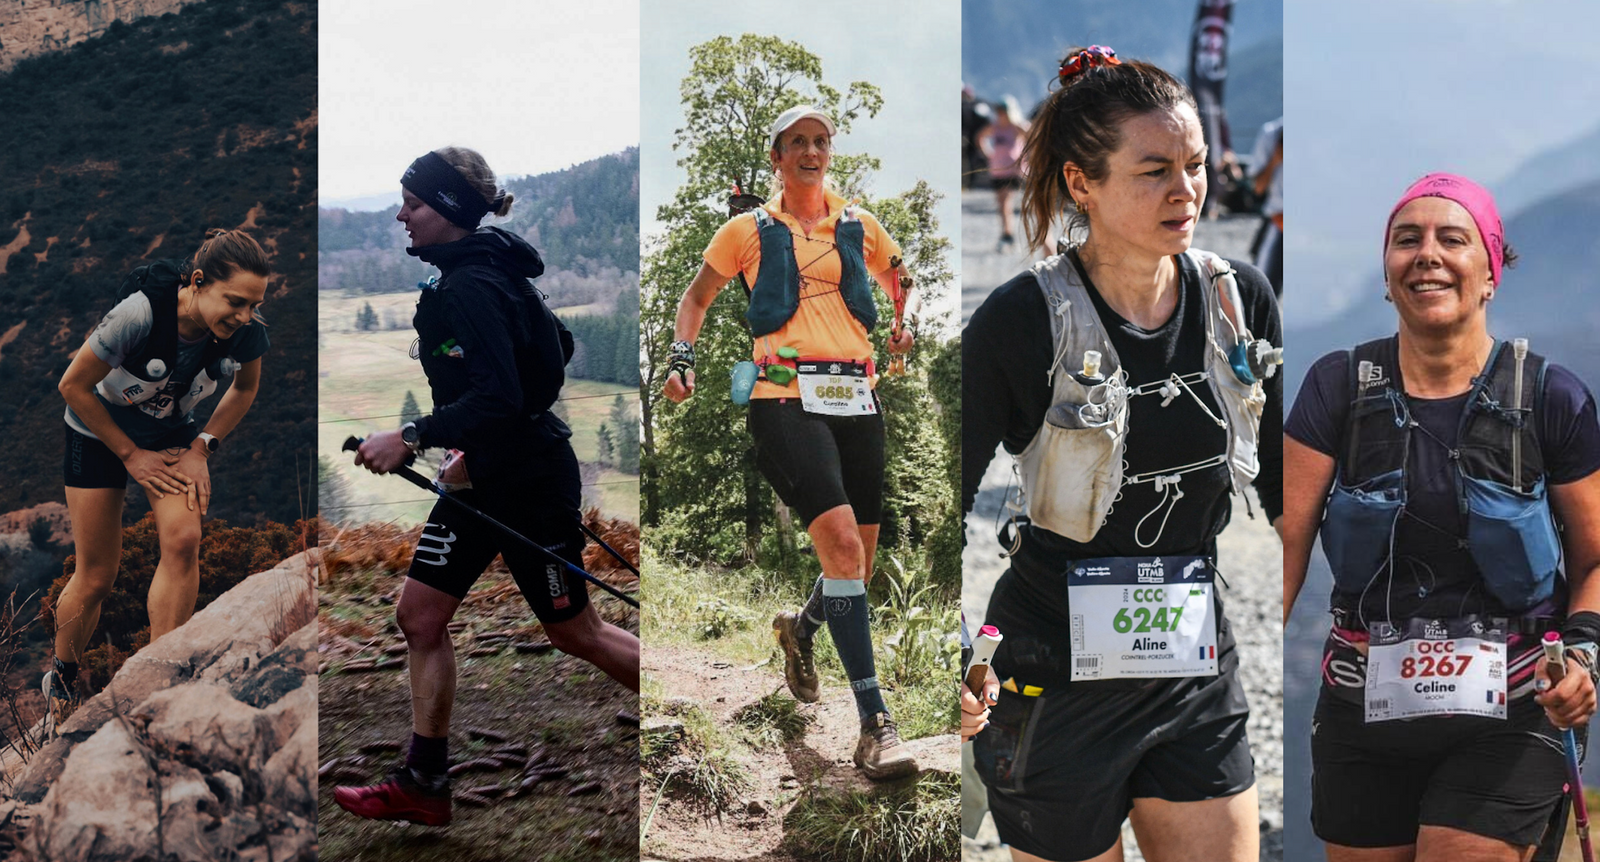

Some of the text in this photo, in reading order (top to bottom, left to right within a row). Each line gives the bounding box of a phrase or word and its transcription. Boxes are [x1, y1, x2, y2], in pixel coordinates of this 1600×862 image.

[815, 385, 854, 400] 6685
[1137, 568, 1164, 577] UTMB
[1113, 606, 1185, 634] 6247
[1132, 637, 1167, 651] Aline
[1417, 641, 1455, 654] OCC
[1400, 655, 1474, 679] 8267
[1414, 681, 1456, 693] Celine
